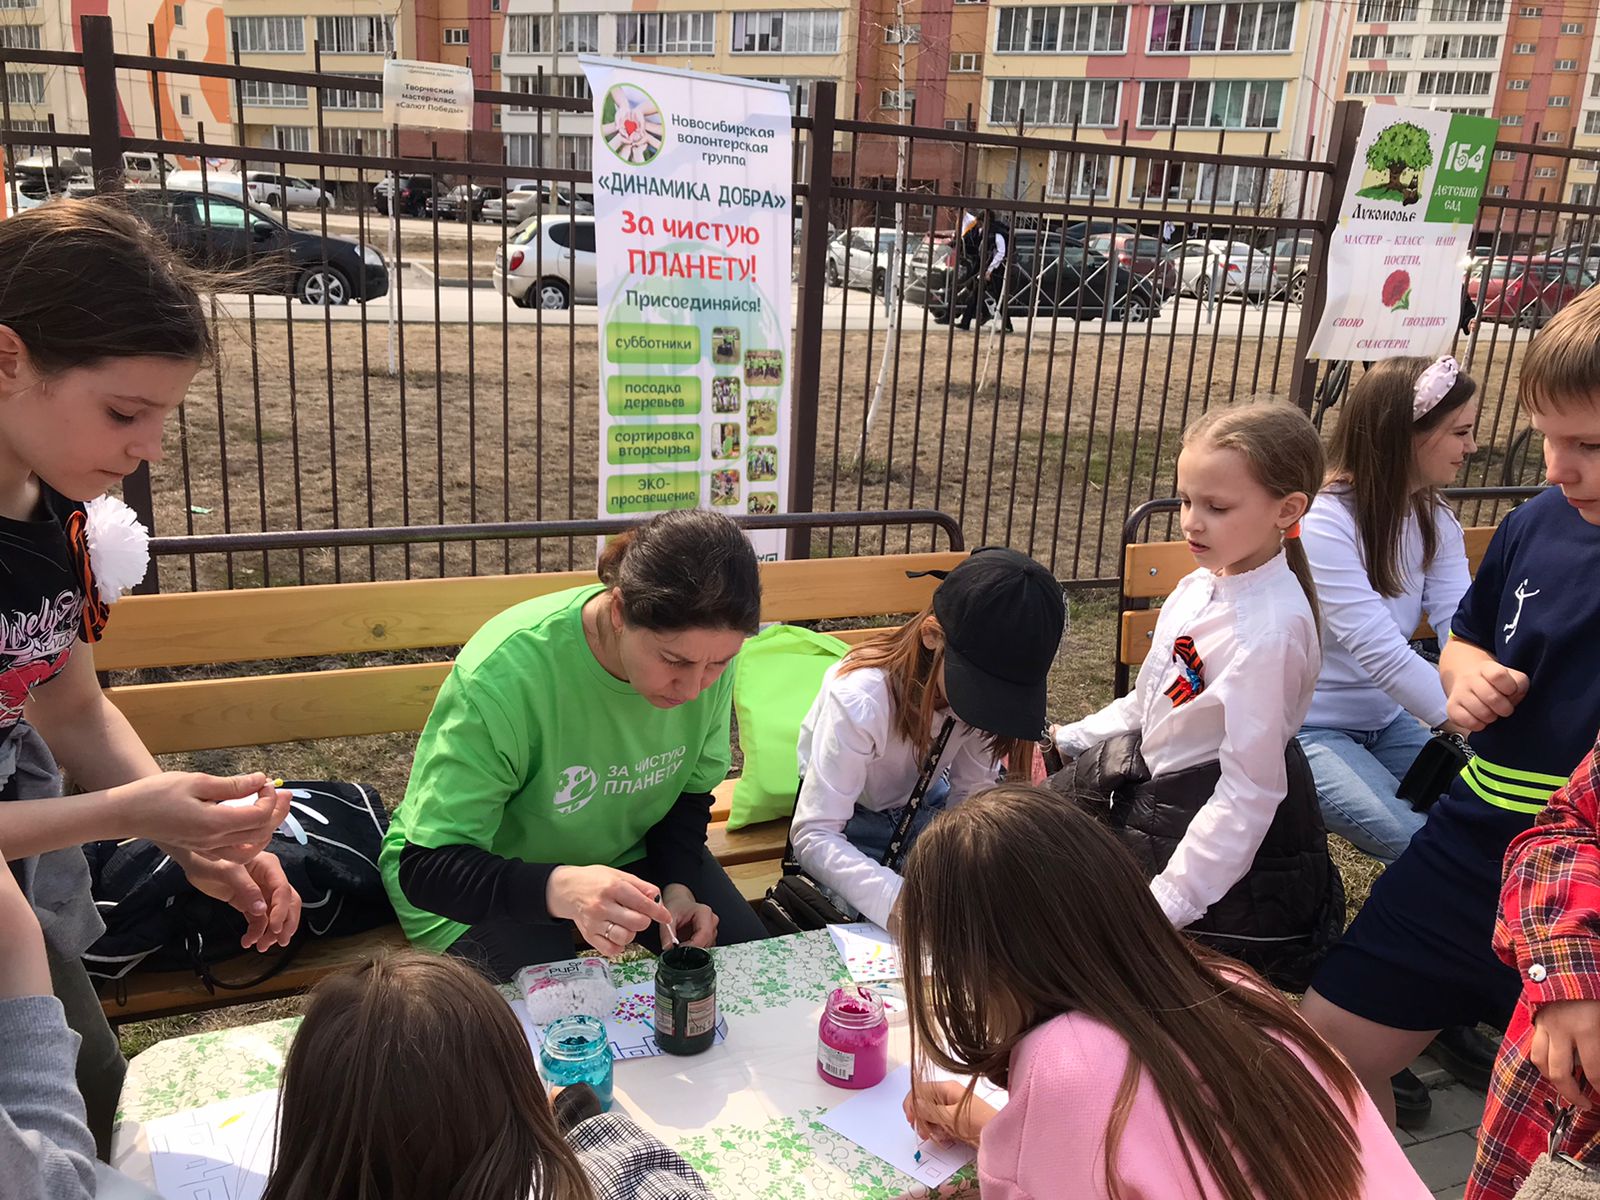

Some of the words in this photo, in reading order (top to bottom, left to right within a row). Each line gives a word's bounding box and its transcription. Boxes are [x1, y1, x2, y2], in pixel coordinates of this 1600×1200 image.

[405, 83, 454, 95] Творческий
[401, 93, 457, 105] мастер-класс
[671, 113, 775, 139] Новосибирская
[677, 132, 768, 154] волонтерская
[701, 151, 746, 166] группа
[1444, 141, 1487, 173] 154
[598, 172, 711, 202] «ДИНАМИКА
[718, 185, 786, 209] ДОБРА»
[620, 210, 655, 236] За
[662, 216, 760, 248] чистую
[1344, 234, 1383, 246] МАСТЕР
[1394, 235, 1425, 246] КЛАСС
[1435, 236, 1457, 247] НАШ
[627, 249, 757, 283] ПЛАНЕТУ!
[626, 290, 761, 313] Присоединяйся!
[1332, 317, 1364, 328] СВОЮ
[615, 335, 692, 351] субботники
[624, 382, 681, 394] посадка
[624, 397, 685, 411] деревьев
[615, 430, 694, 445] сортировка
[618, 445, 691, 459] вторсырья
[637, 478, 671, 491] ЭКО-
[611, 491, 696, 508] просвещение
[607, 765, 629, 777] ЗА
[634, 745, 687, 774] ЧИСТУЮ
[603, 759, 684, 796] ПЛАНЕТУ
